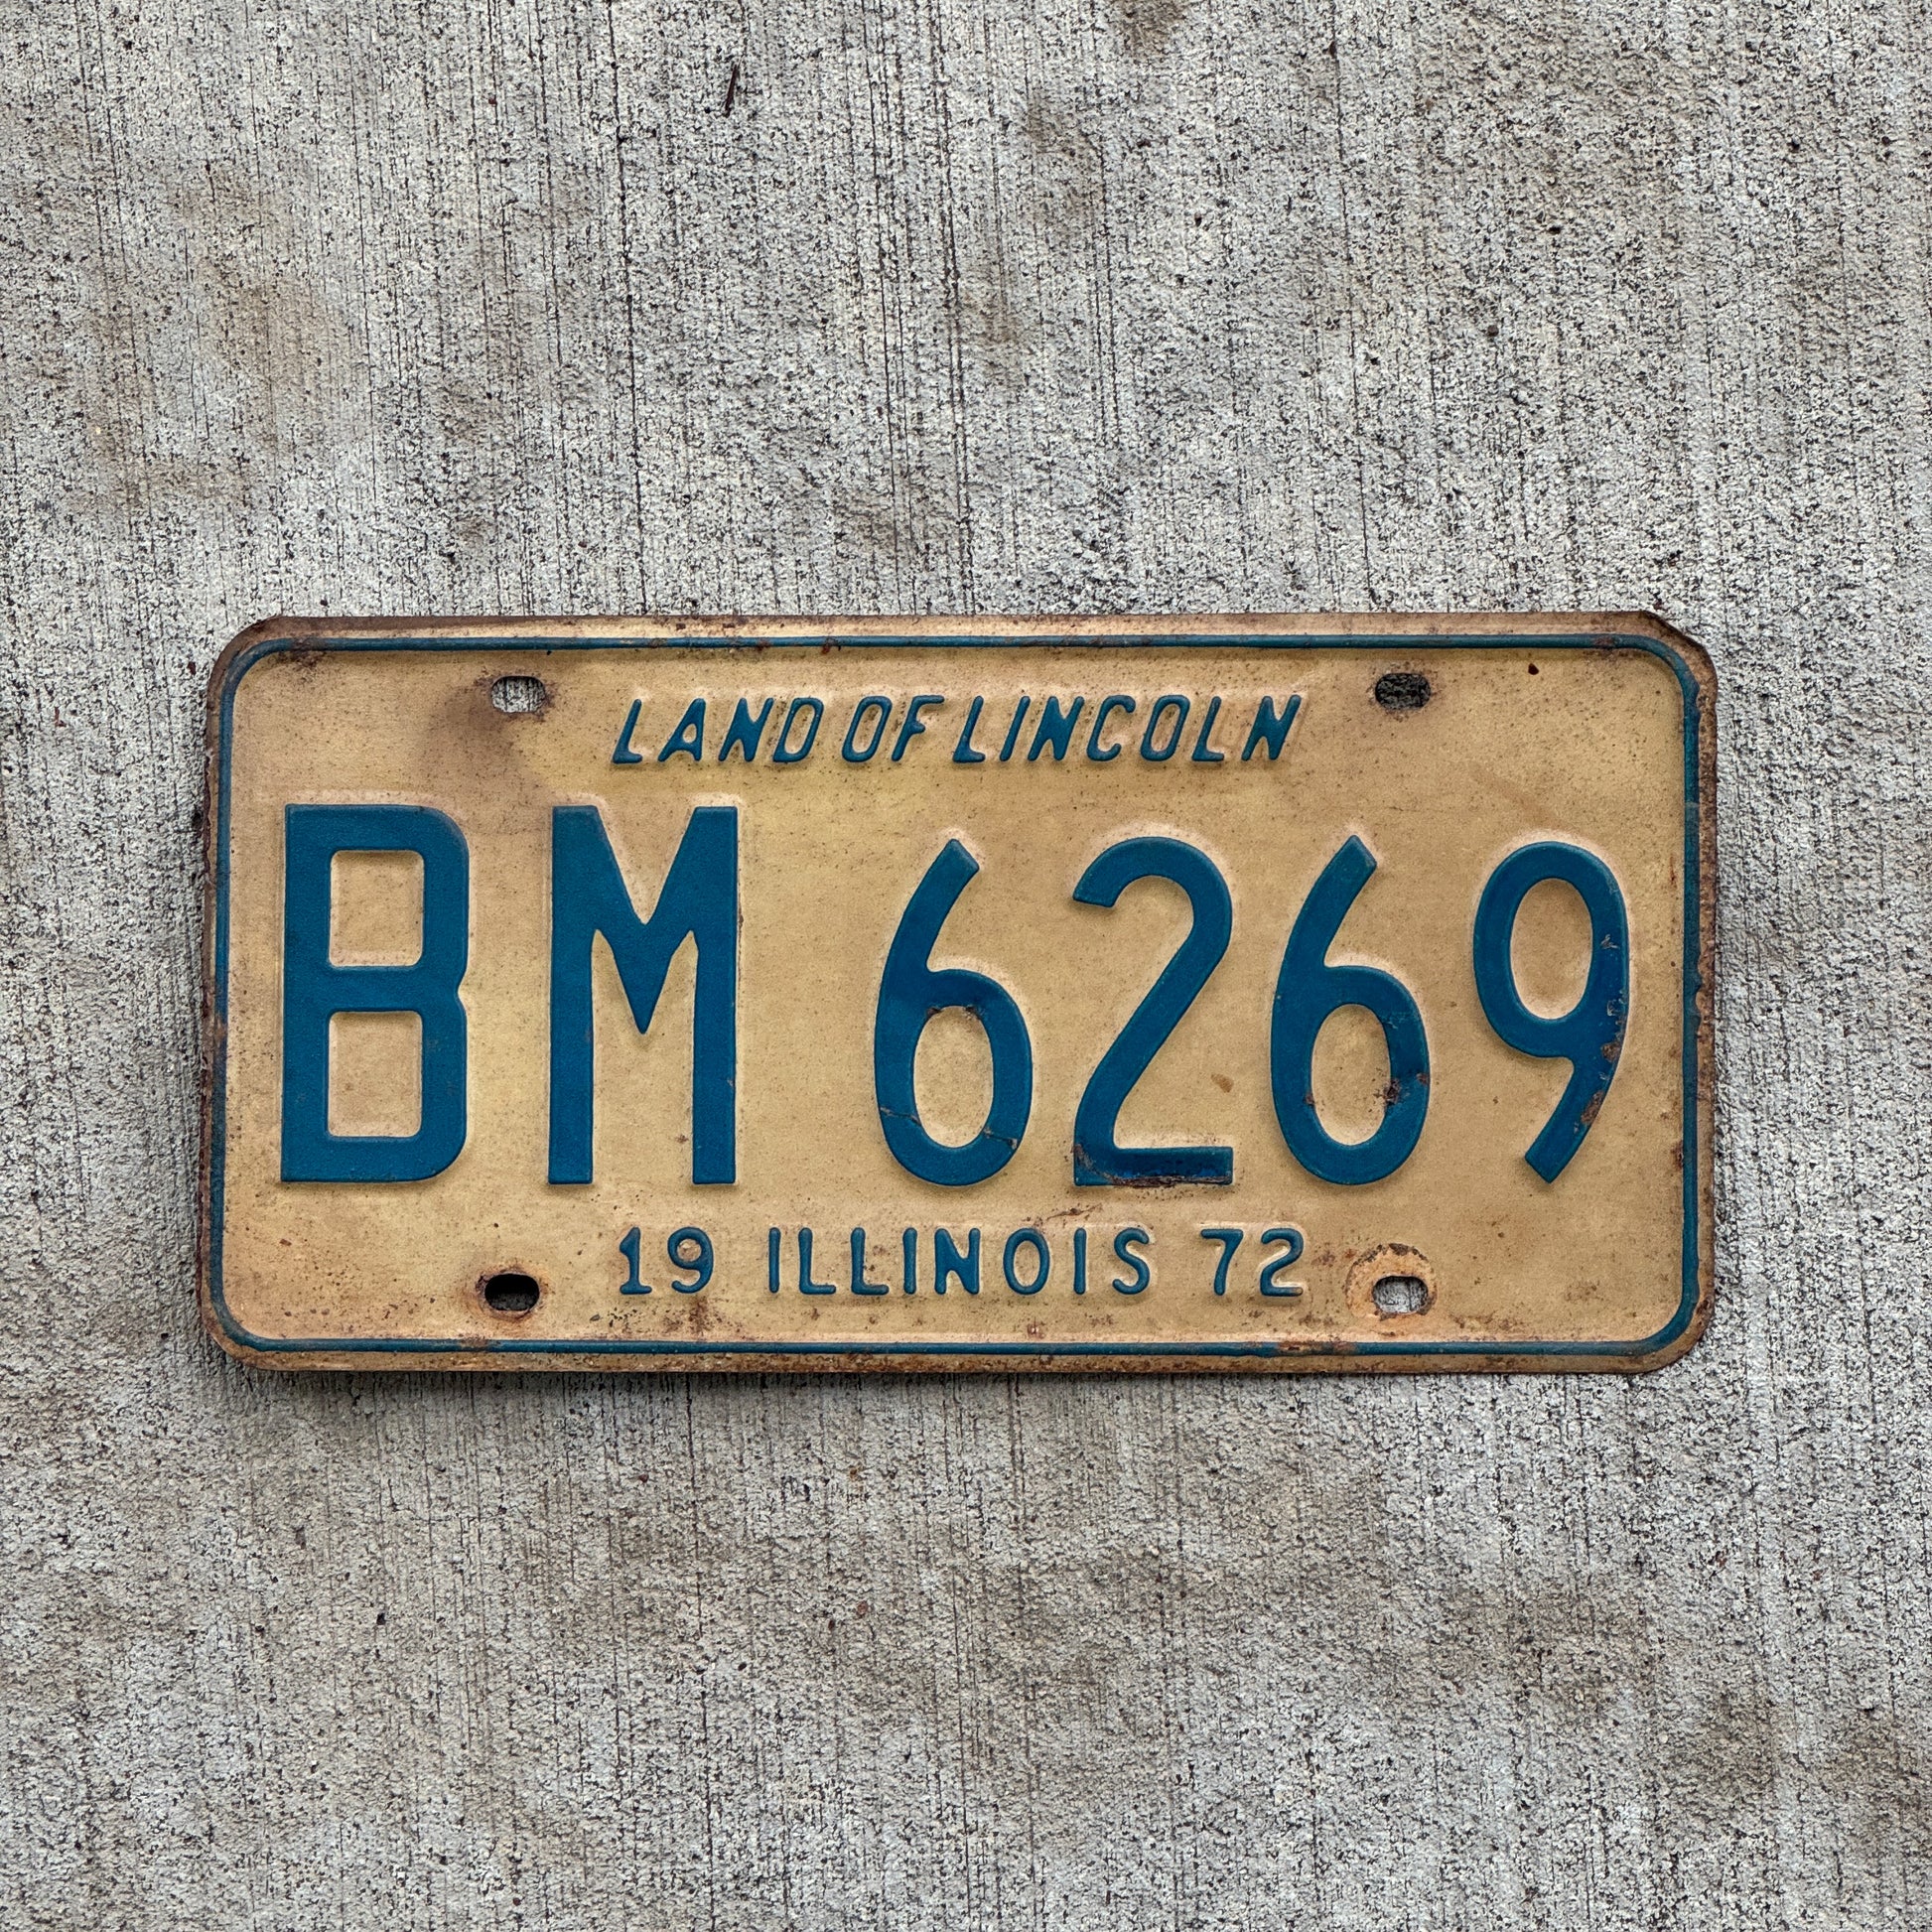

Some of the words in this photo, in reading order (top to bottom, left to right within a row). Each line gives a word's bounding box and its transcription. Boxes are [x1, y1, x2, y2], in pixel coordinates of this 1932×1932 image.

[612, 696, 825, 763] LAND
[841, 695, 944, 762] OF
[952, 695, 1302, 762] LINCOLN
[282, 804, 739, 1185] BM
[874, 834, 1630, 1186] 6269
[619, 1227, 715, 1295] 19
[767, 1227, 1151, 1296] ILLINOIS
[1200, 1227, 1305, 1296] 72
